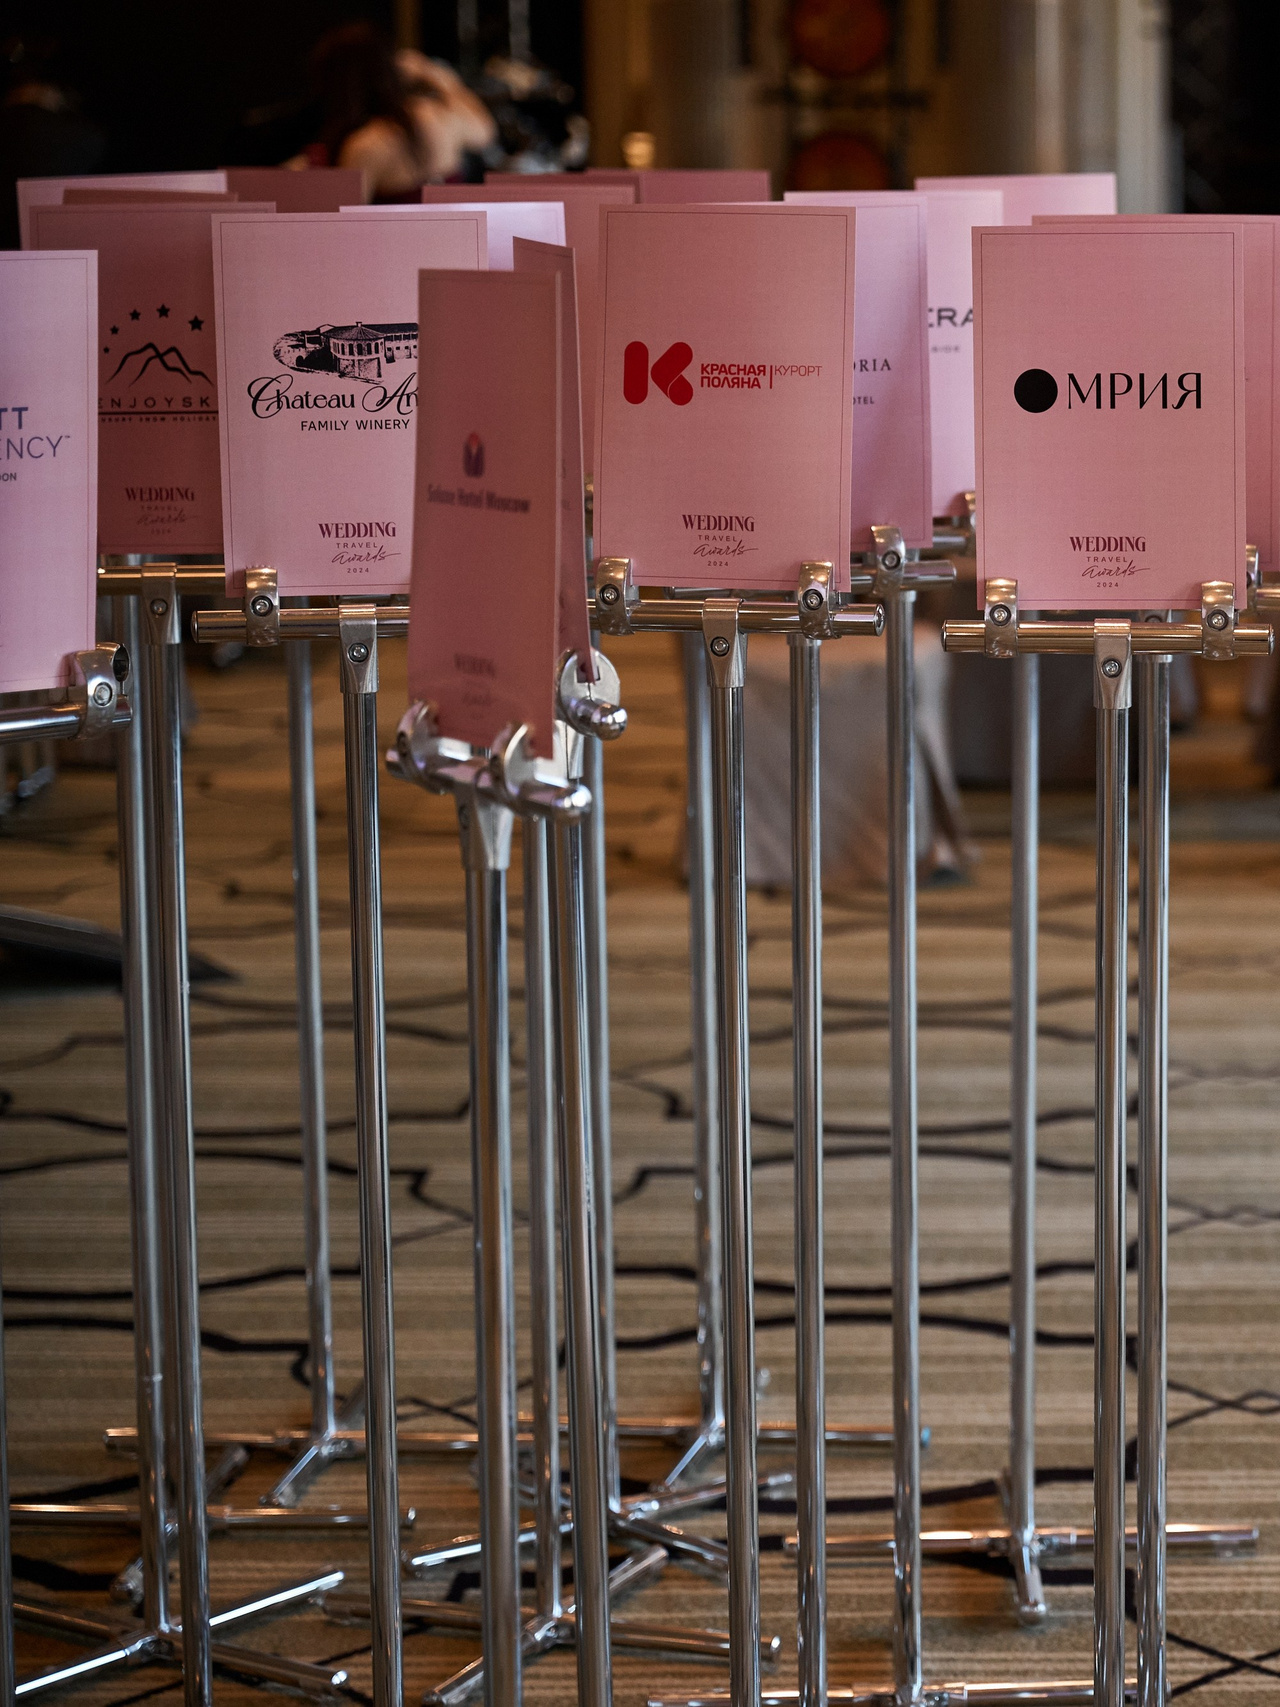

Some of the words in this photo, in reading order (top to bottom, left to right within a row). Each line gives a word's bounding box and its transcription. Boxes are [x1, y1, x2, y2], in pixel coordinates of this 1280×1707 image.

[700, 363, 767, 377] КРАСНАЯ
[774, 364, 823, 377] КУРОРТ
[853, 357, 892, 373] RIA
[700, 376, 762, 389] ПОЛЯНА
[247, 373, 356, 419] Chateau
[1067, 372, 1202, 410] МРИЯ
[300, 420, 349, 432] FAMILY
[355, 418, 411, 431] WINERY
[124, 486, 196, 502] WEDDING
[318, 521, 397, 539] WEDDING
[681, 514, 756, 532] WEDDING
[335, 541, 378, 549] TRAVEL
[697, 534, 738, 542] TRAVEL
[1069, 536, 1147, 552] WEDDING
[331, 544, 402, 565] awards
[693, 539, 759, 557] awards
[1081, 559, 1151, 579] awards
